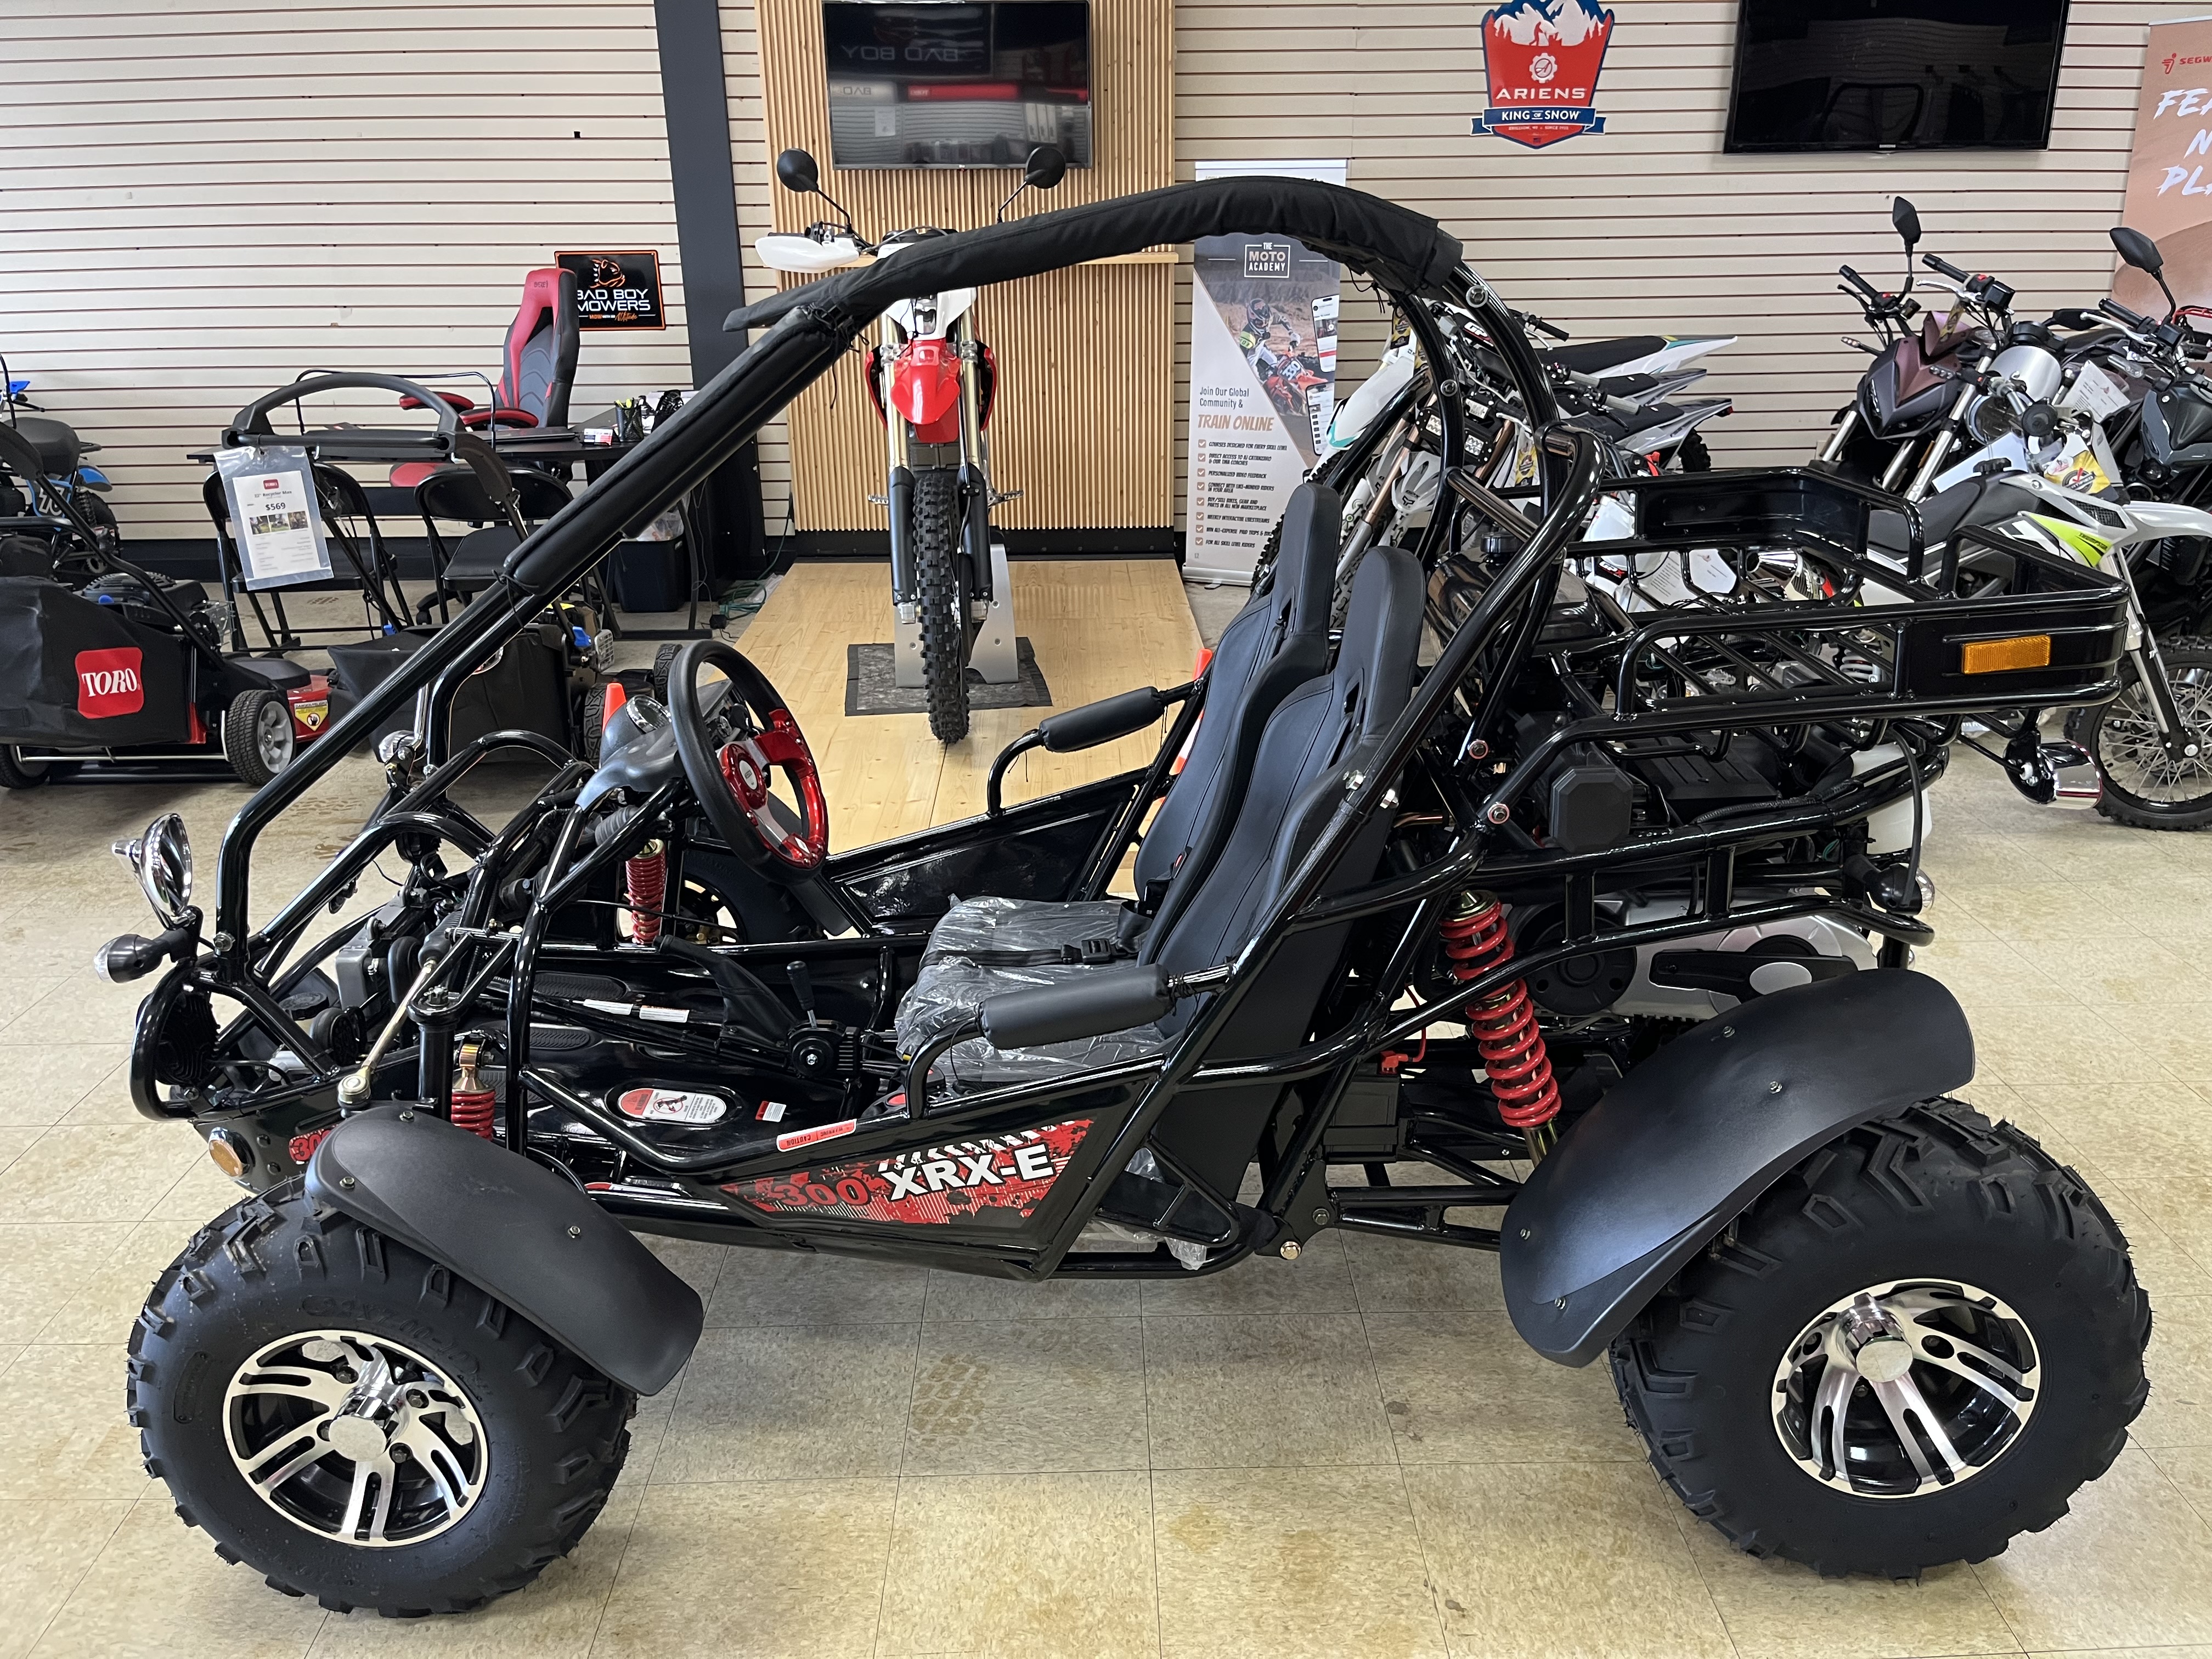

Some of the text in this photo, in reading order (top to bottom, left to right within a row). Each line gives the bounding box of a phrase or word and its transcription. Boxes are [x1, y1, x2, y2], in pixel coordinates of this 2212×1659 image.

[1496, 88, 1586, 100] ARIENS
[1502, 110, 1530, 120] KING
[1544, 110, 1579, 120] SNOW
[1263, 242, 1273, 250] THE
[1249, 251, 1286, 261] MOTO
[1248, 262, 1285, 272] ACADEMY
[577, 289, 648, 300] BAD BOY
[577, 300, 651, 311] MOWERS
[1200, 386, 1249, 397] Join Our Global
[1200, 398, 1243, 410] Community &
[1198, 414, 1274, 431] TRAIN ONLINE
[266, 503, 286, 511] $569
[82, 668, 138, 698] TORO
[292, 1130, 332, 1161] 30
[786, 1134, 811, 1147] CAUTION
[774, 1144, 1054, 1206] 300 XRX-E
